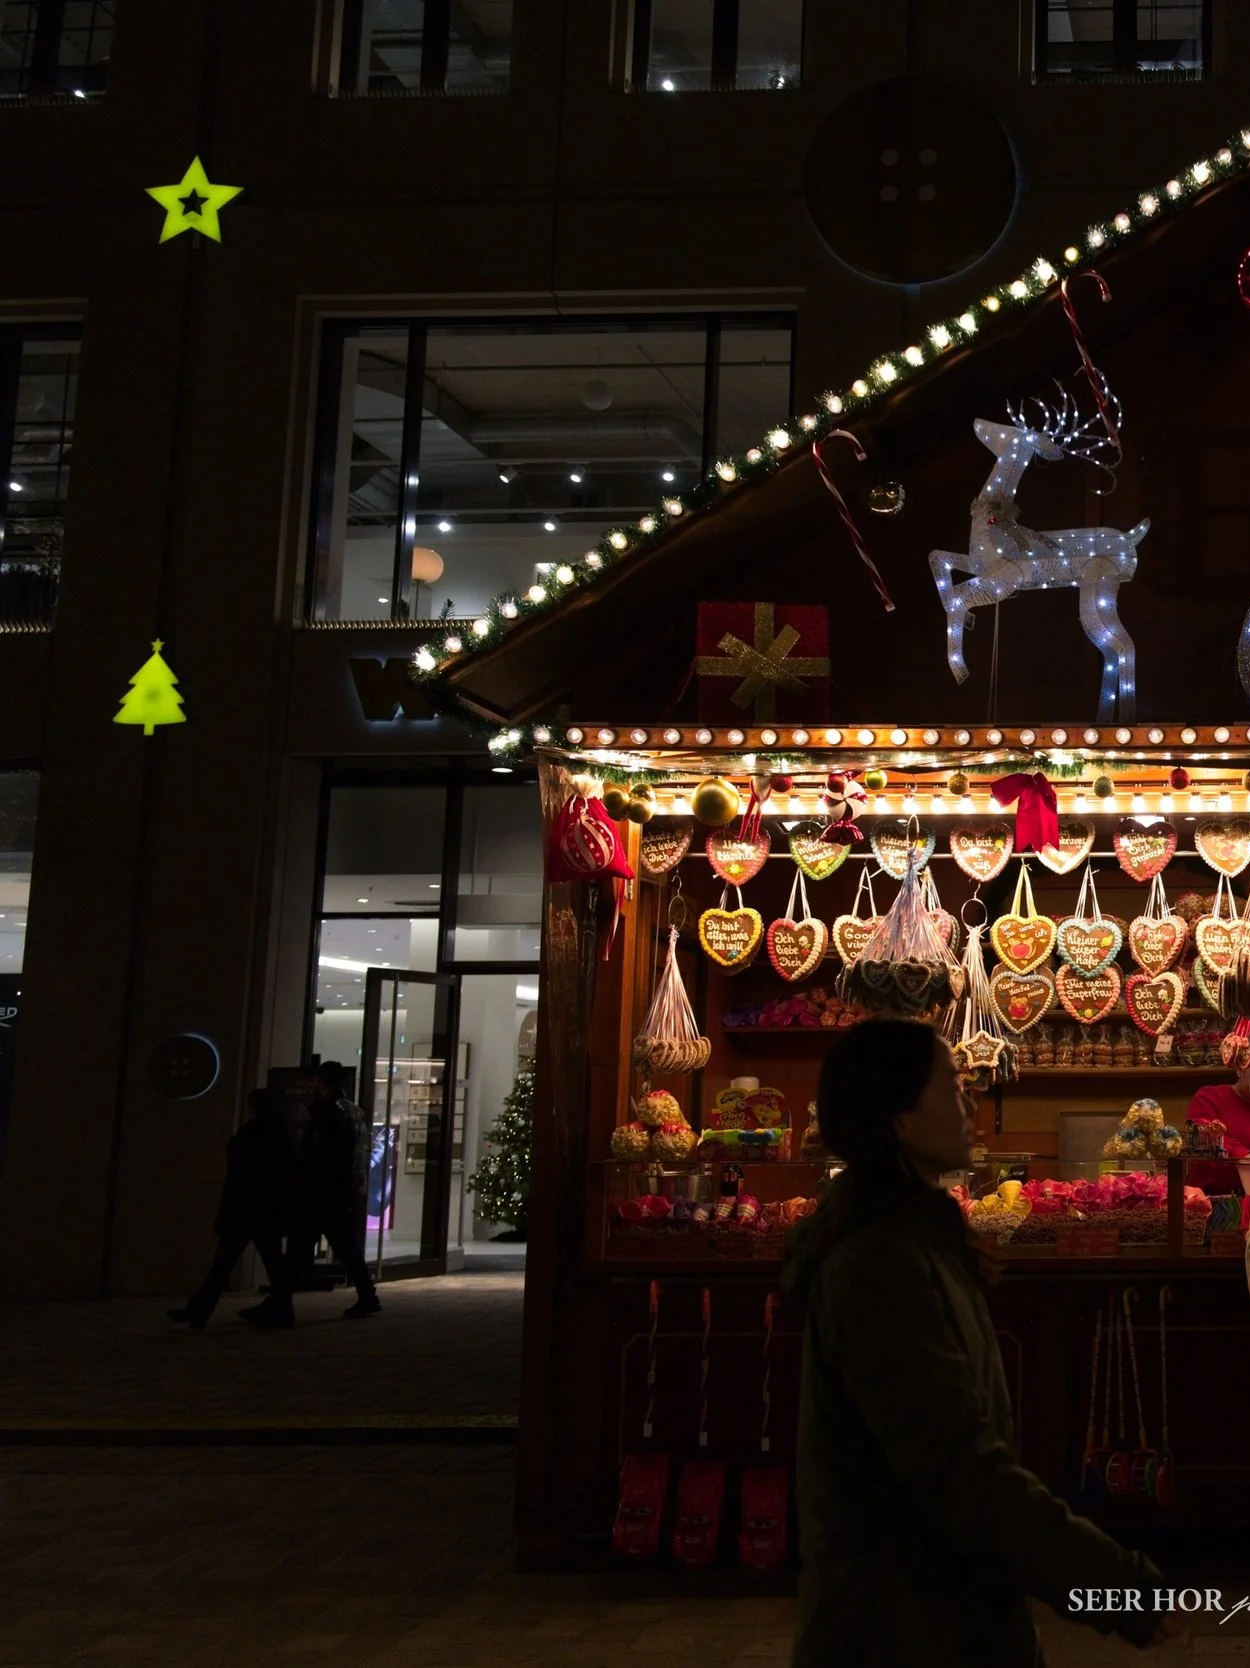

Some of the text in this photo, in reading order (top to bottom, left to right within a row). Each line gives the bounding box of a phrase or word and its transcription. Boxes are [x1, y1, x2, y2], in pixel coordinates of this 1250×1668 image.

[960, 836, 994, 847] Du bist
[649, 851, 670, 863] Dich
[705, 920, 741, 931] Du bist
[774, 932, 796, 944] Ich
[1066, 929, 1099, 946] Kleiner
[1147, 930, 1164, 941] Ich
[712, 940, 744, 951] ich will
[775, 945, 799, 955] liebe
[1143, 940, 1164, 951] liebe
[778, 956, 803, 967] Dich
[1140, 951, 1164, 964] Dich
[1065, 978, 1113, 989] Für meine
[1066, 987, 1114, 1001] Superfrau
[1134, 988, 1153, 1000] Ich
[1135, 1000, 1161, 1010] liebe
[1140, 1010, 1164, 1021] Dich
